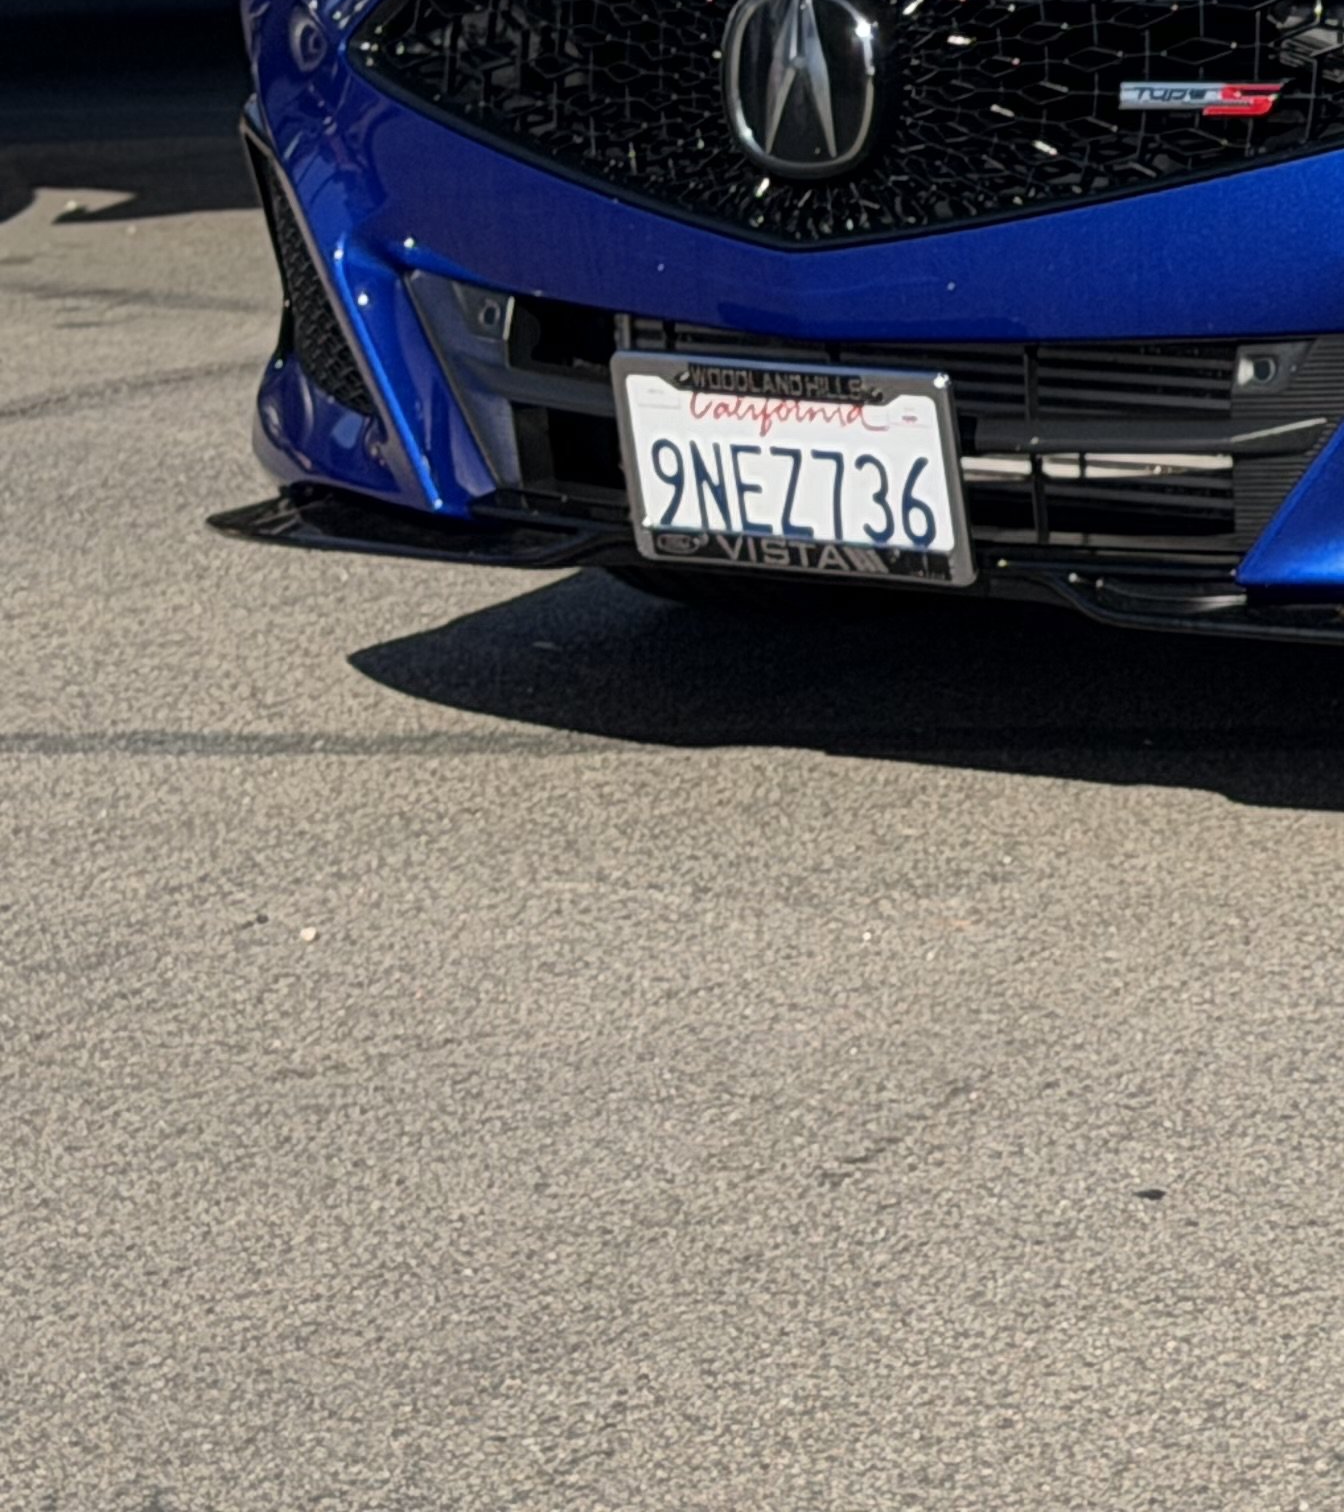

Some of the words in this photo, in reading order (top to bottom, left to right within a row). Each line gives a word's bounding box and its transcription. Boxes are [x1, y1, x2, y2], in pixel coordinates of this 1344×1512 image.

[1202, 83, 1281, 116] S
[690, 365, 805, 397] WOODLAND
[803, 375, 863, 402] HILLS
[689, 391, 889, 437] California
[651, 438, 936, 548] 9NEZ736
[716, 533, 851, 572] VISTA
